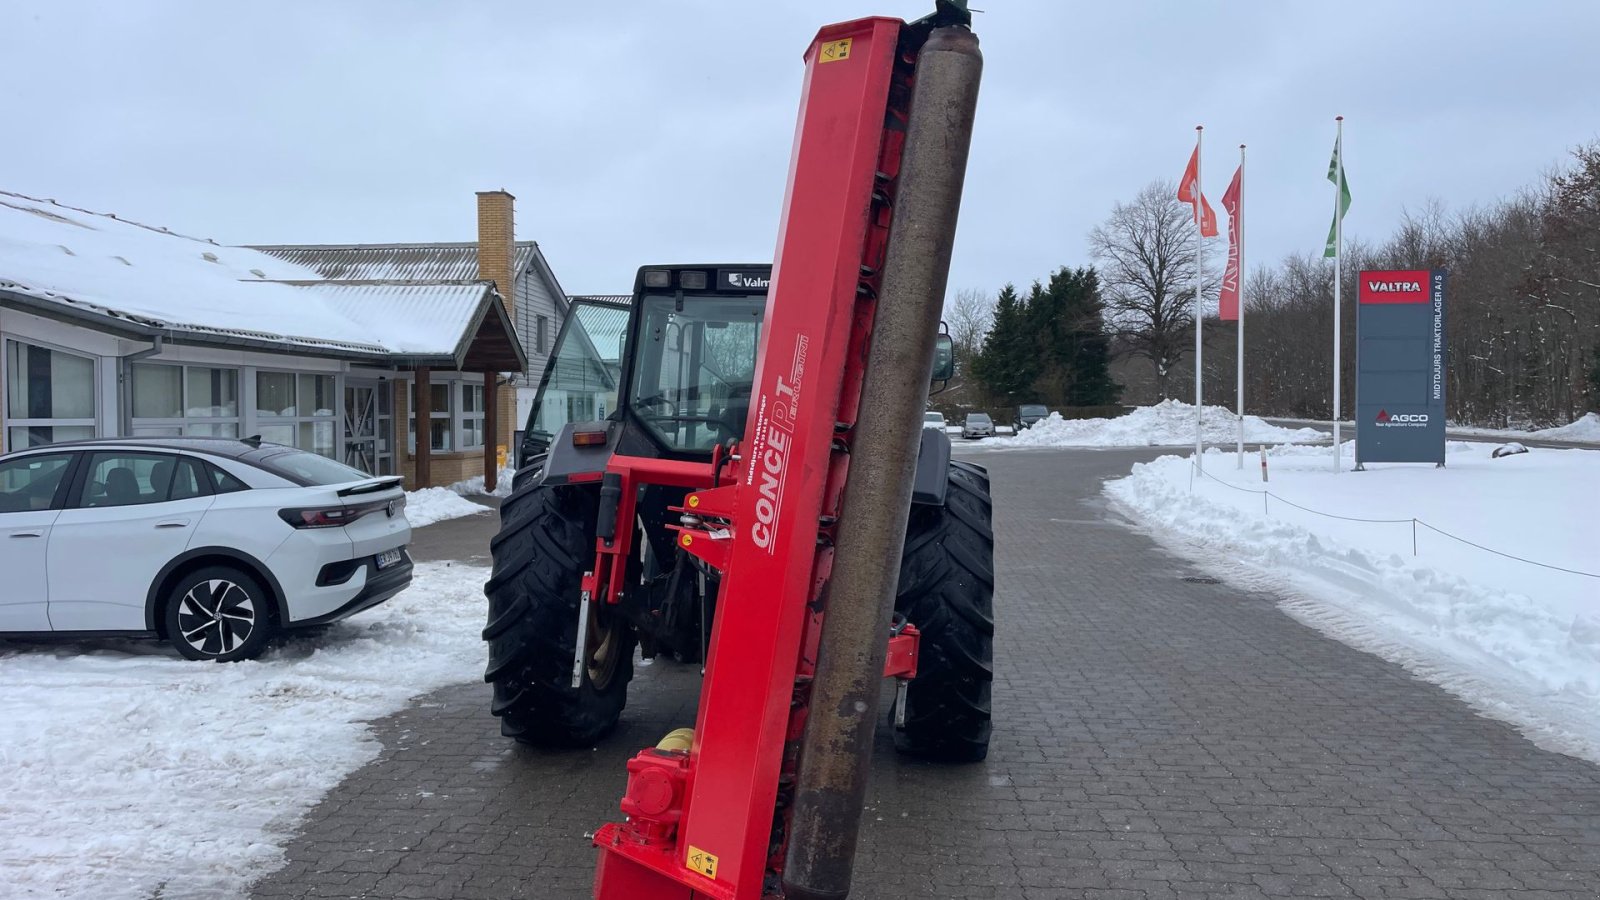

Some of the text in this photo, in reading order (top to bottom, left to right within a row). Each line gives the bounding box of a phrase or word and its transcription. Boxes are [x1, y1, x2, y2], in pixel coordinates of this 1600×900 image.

[1368, 281, 1421, 292] VALTRA
[1433, 275, 1442, 400] MIDTDJURS TRAKTORLAGER A/S
[747, 394, 767, 486] Midtdjurs Traktorlager
[752, 375, 795, 549] CONCEPT
[1390, 414, 1429, 422] AGCO
